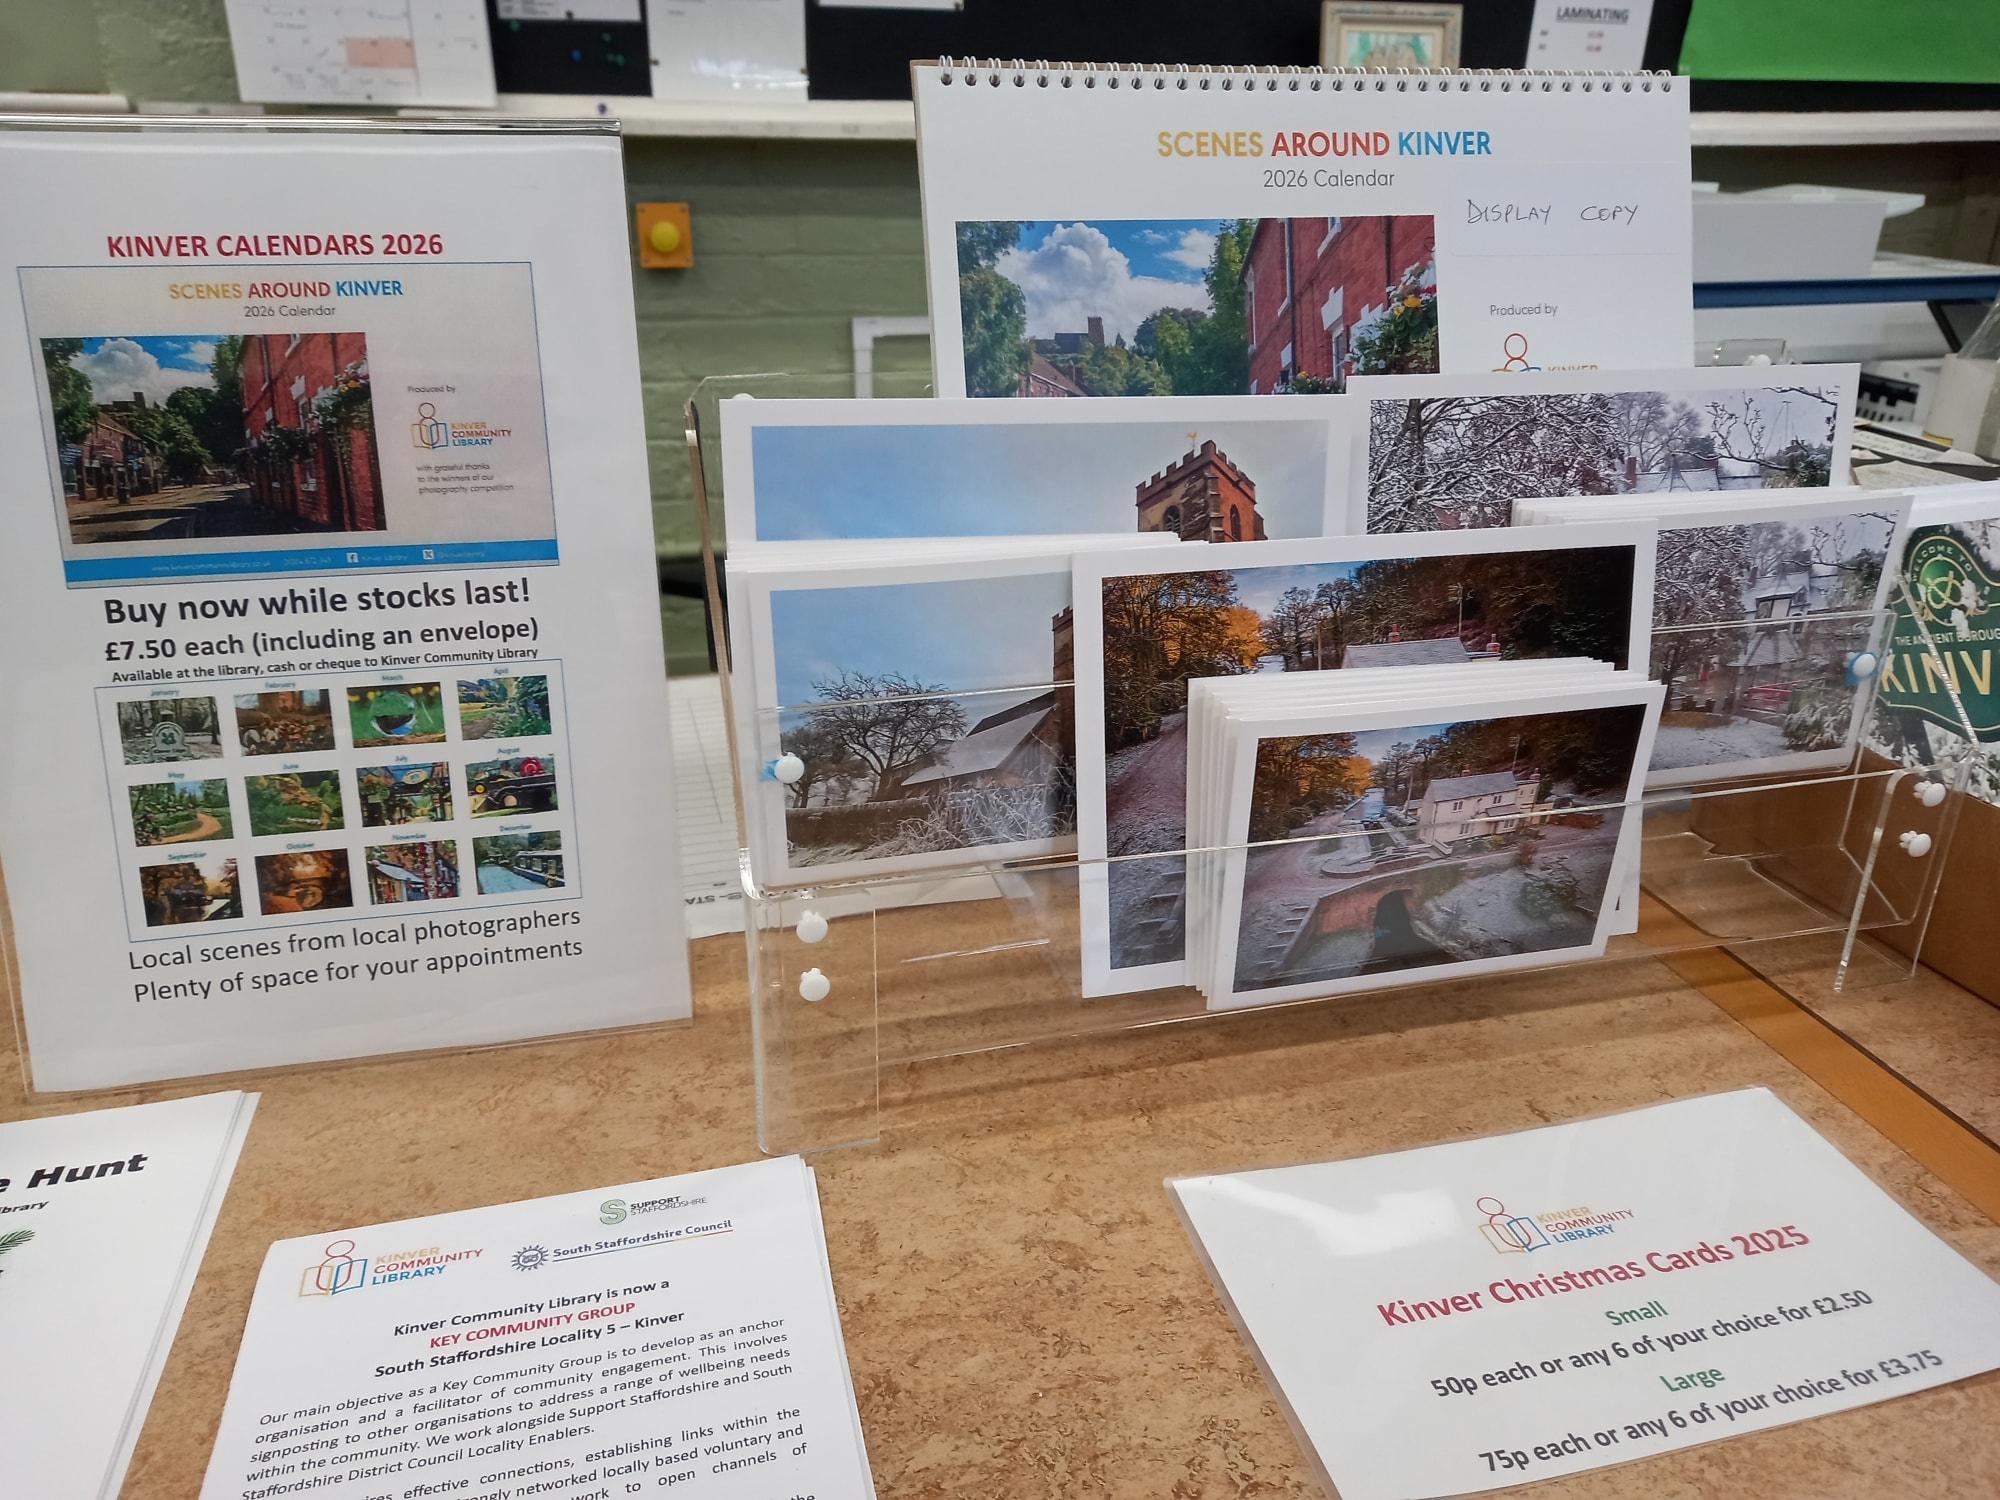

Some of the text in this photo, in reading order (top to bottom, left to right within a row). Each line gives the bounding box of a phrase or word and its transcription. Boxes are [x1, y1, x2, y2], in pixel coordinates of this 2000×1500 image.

[1557, 7, 1629, 21] LAMINATING
[1157, 130, 1492, 158] SCENES AROUND KINVER
[1263, 169, 1395, 188] 2026 Calendar
[1467, 200, 1639, 225] DISPLAY COPY
[107, 233, 444, 258] KINVER CALENDARS 2026
[169, 279, 404, 299] SCENES AROUND KINVER
[243, 302, 336, 318] 2026 Calendar
[1490, 303, 1558, 317] Produced by
[452, 430, 512, 438] COMMUNITY
[453, 438, 493, 447] LIBRARY
[104, 577, 530, 628] Buy now while stocks last!
[105, 617, 540, 662] £7.50 each (including an envelope)
[1894, 635, 1912, 646] THE
[1913, 632, 1953, 645] ANIENT
[112, 647, 538, 682] Available at the library, cash or cheque to Kinver Community Library
[129, 909, 581, 970] Local scenes from local photographers
[134, 939, 582, 1002] Plenty of space for your appointments
[27, 1154, 148, 1189] Hunt
[630, 1195, 682, 1210] SUPPORT
[630, 1197, 708, 1216] STAFFORDSHIRE
[1537, 1207, 1592, 1223] KINVER
[1545, 1209, 1635, 1232] COMMUNITY
[553, 1219, 733, 1258] South Staffordshire Council
[1552, 1224, 1615, 1243] LIBRARY
[374, 1249, 483, 1274] COMMUNITY
[376, 1247, 440, 1264] KINVER
[372, 1265, 446, 1285] LIBRARY
[1377, 1225, 1810, 1326] Kinver Christmas Cards 2025
[394, 1280, 670, 1336] Kinver Community Library is now a
[1605, 1300, 1669, 1326] Small
[430, 1302, 636, 1349] KEY COMMUNITY GROUP
[374, 1311, 685, 1378] South Staffordshire Locality 5 Kinver
[1430, 1289, 1874, 1397] 50p each or any 6 of your choice for £2.50
[259, 1319, 784, 1426] Our main objective as a Key Community Group is to develop as an anchor
[1659, 1368, 1726, 1392] Large
[255, 1333, 788, 1444] organisation and a facilitator of community engagement. This involves
[1479, 1350, 1944, 1472] 75p each or any 6 of your choice for £3.75
